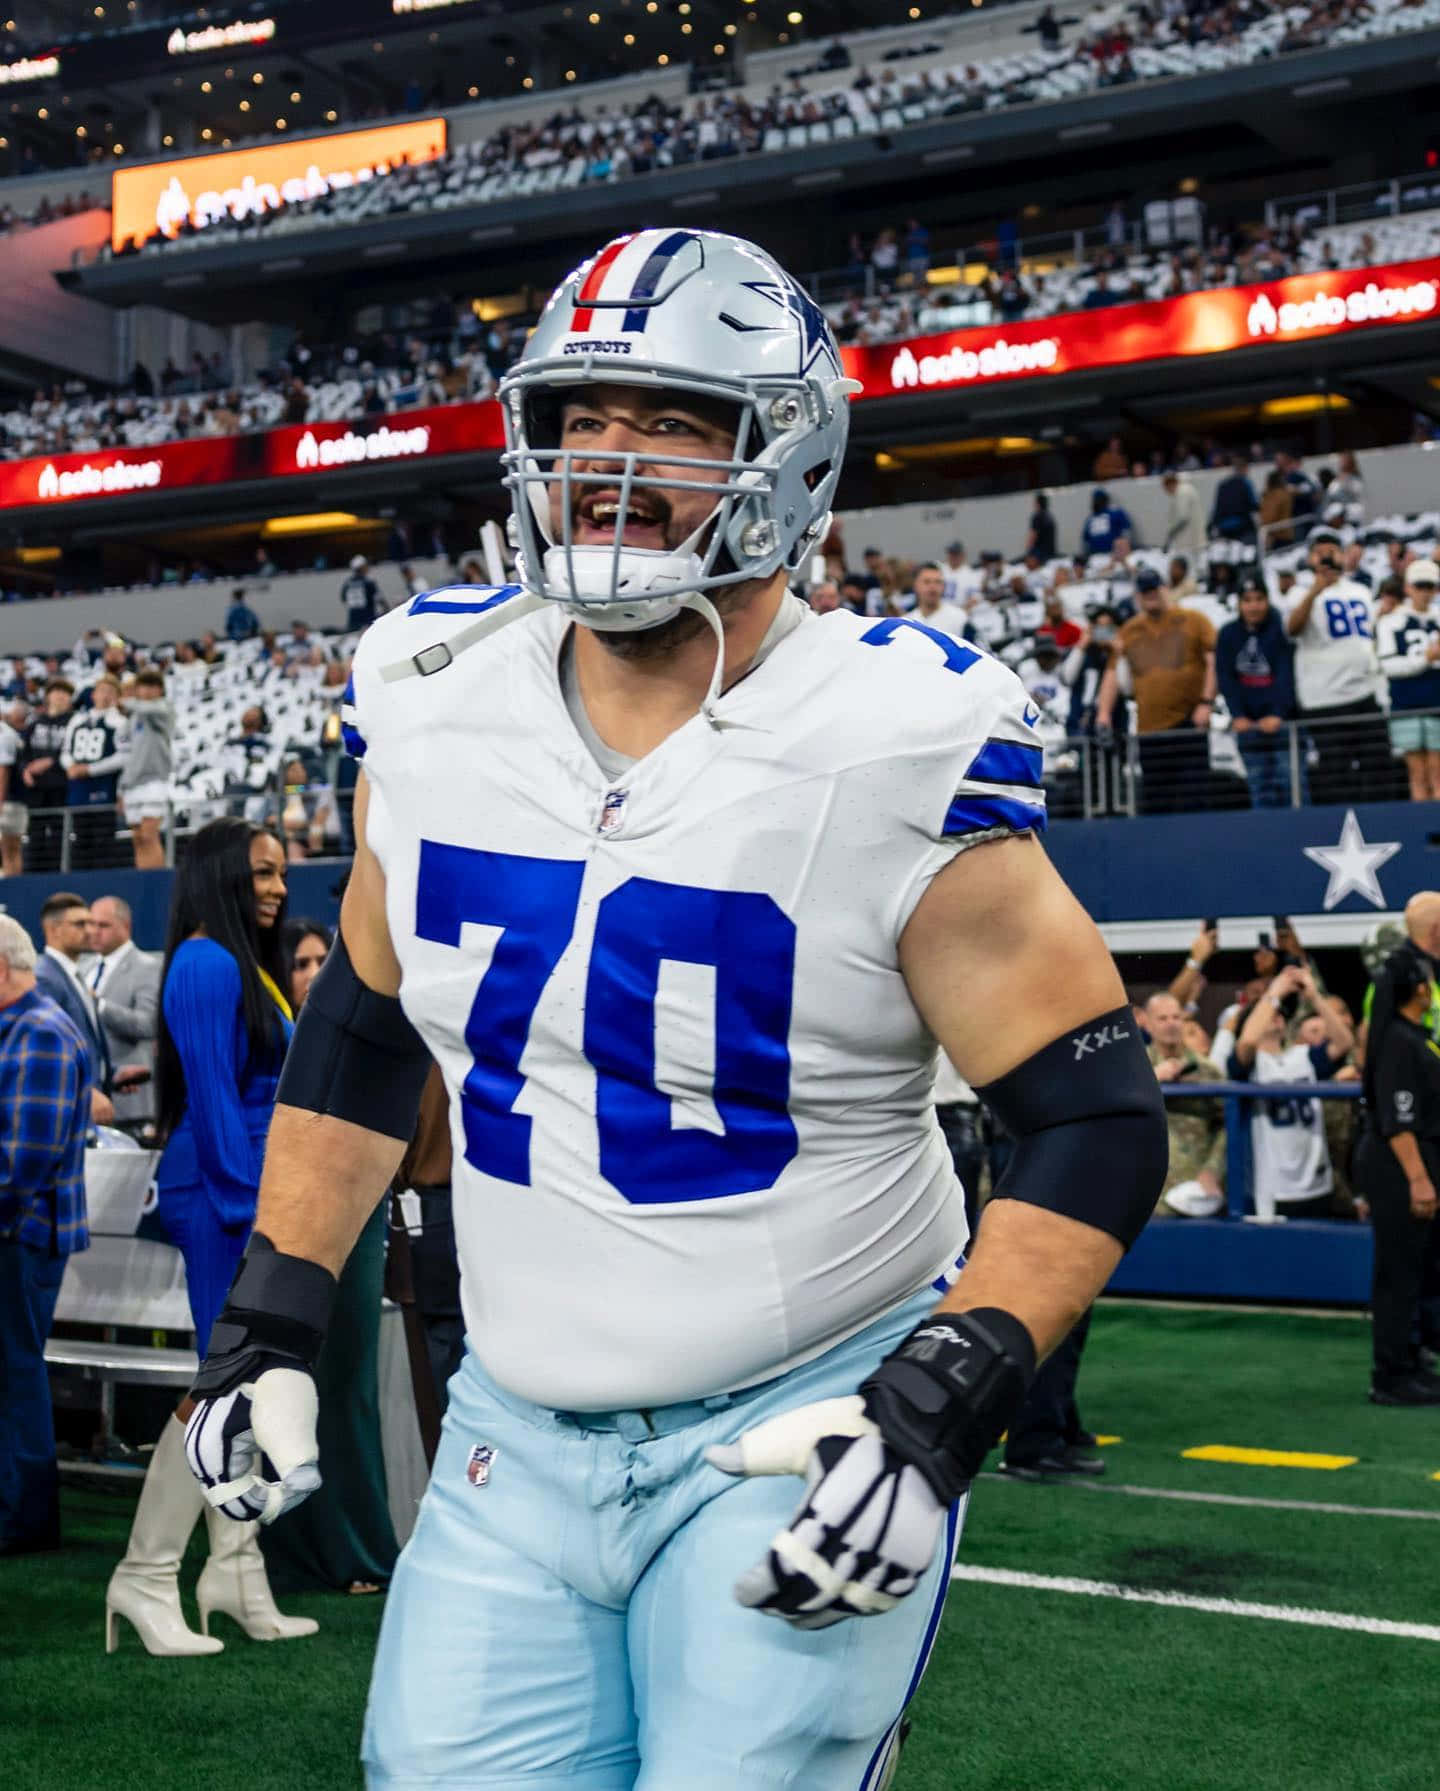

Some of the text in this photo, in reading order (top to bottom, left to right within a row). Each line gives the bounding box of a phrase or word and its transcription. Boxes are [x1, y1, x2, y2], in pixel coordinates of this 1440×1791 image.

[1278, 291, 1346, 331] solo
[563, 340, 632, 354] COWBOYS
[1326, 599, 1374, 640] 82
[416, 838, 799, 1204] 70
[1073, 1025, 1130, 1060] XXL
